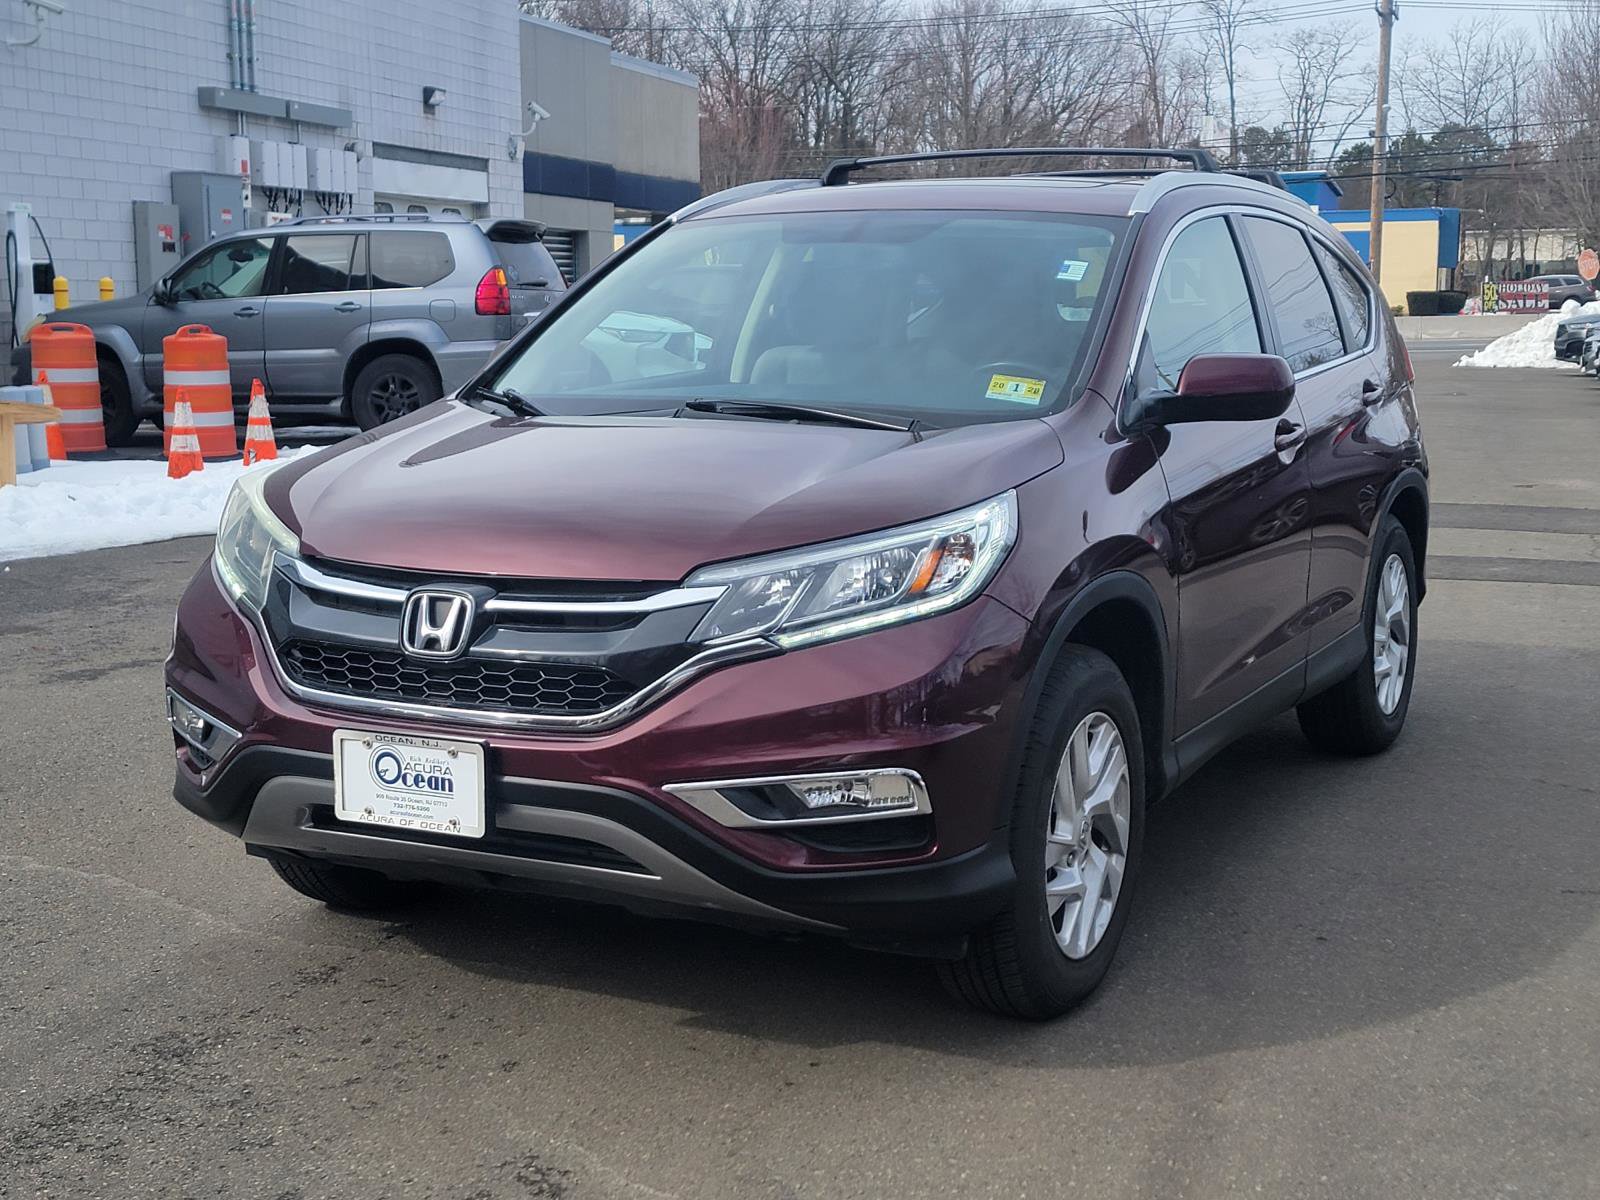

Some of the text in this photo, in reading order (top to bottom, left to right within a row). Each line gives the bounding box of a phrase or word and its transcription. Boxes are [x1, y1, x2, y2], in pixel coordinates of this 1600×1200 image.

[1500, 292, 1547, 309] SALE
[1012, 383, 1020, 393] 1
[375, 751, 454, 793] Ocean
[403, 762, 453, 776] ACURA
[359, 813, 461, 833] ACURA OF OCEAN
